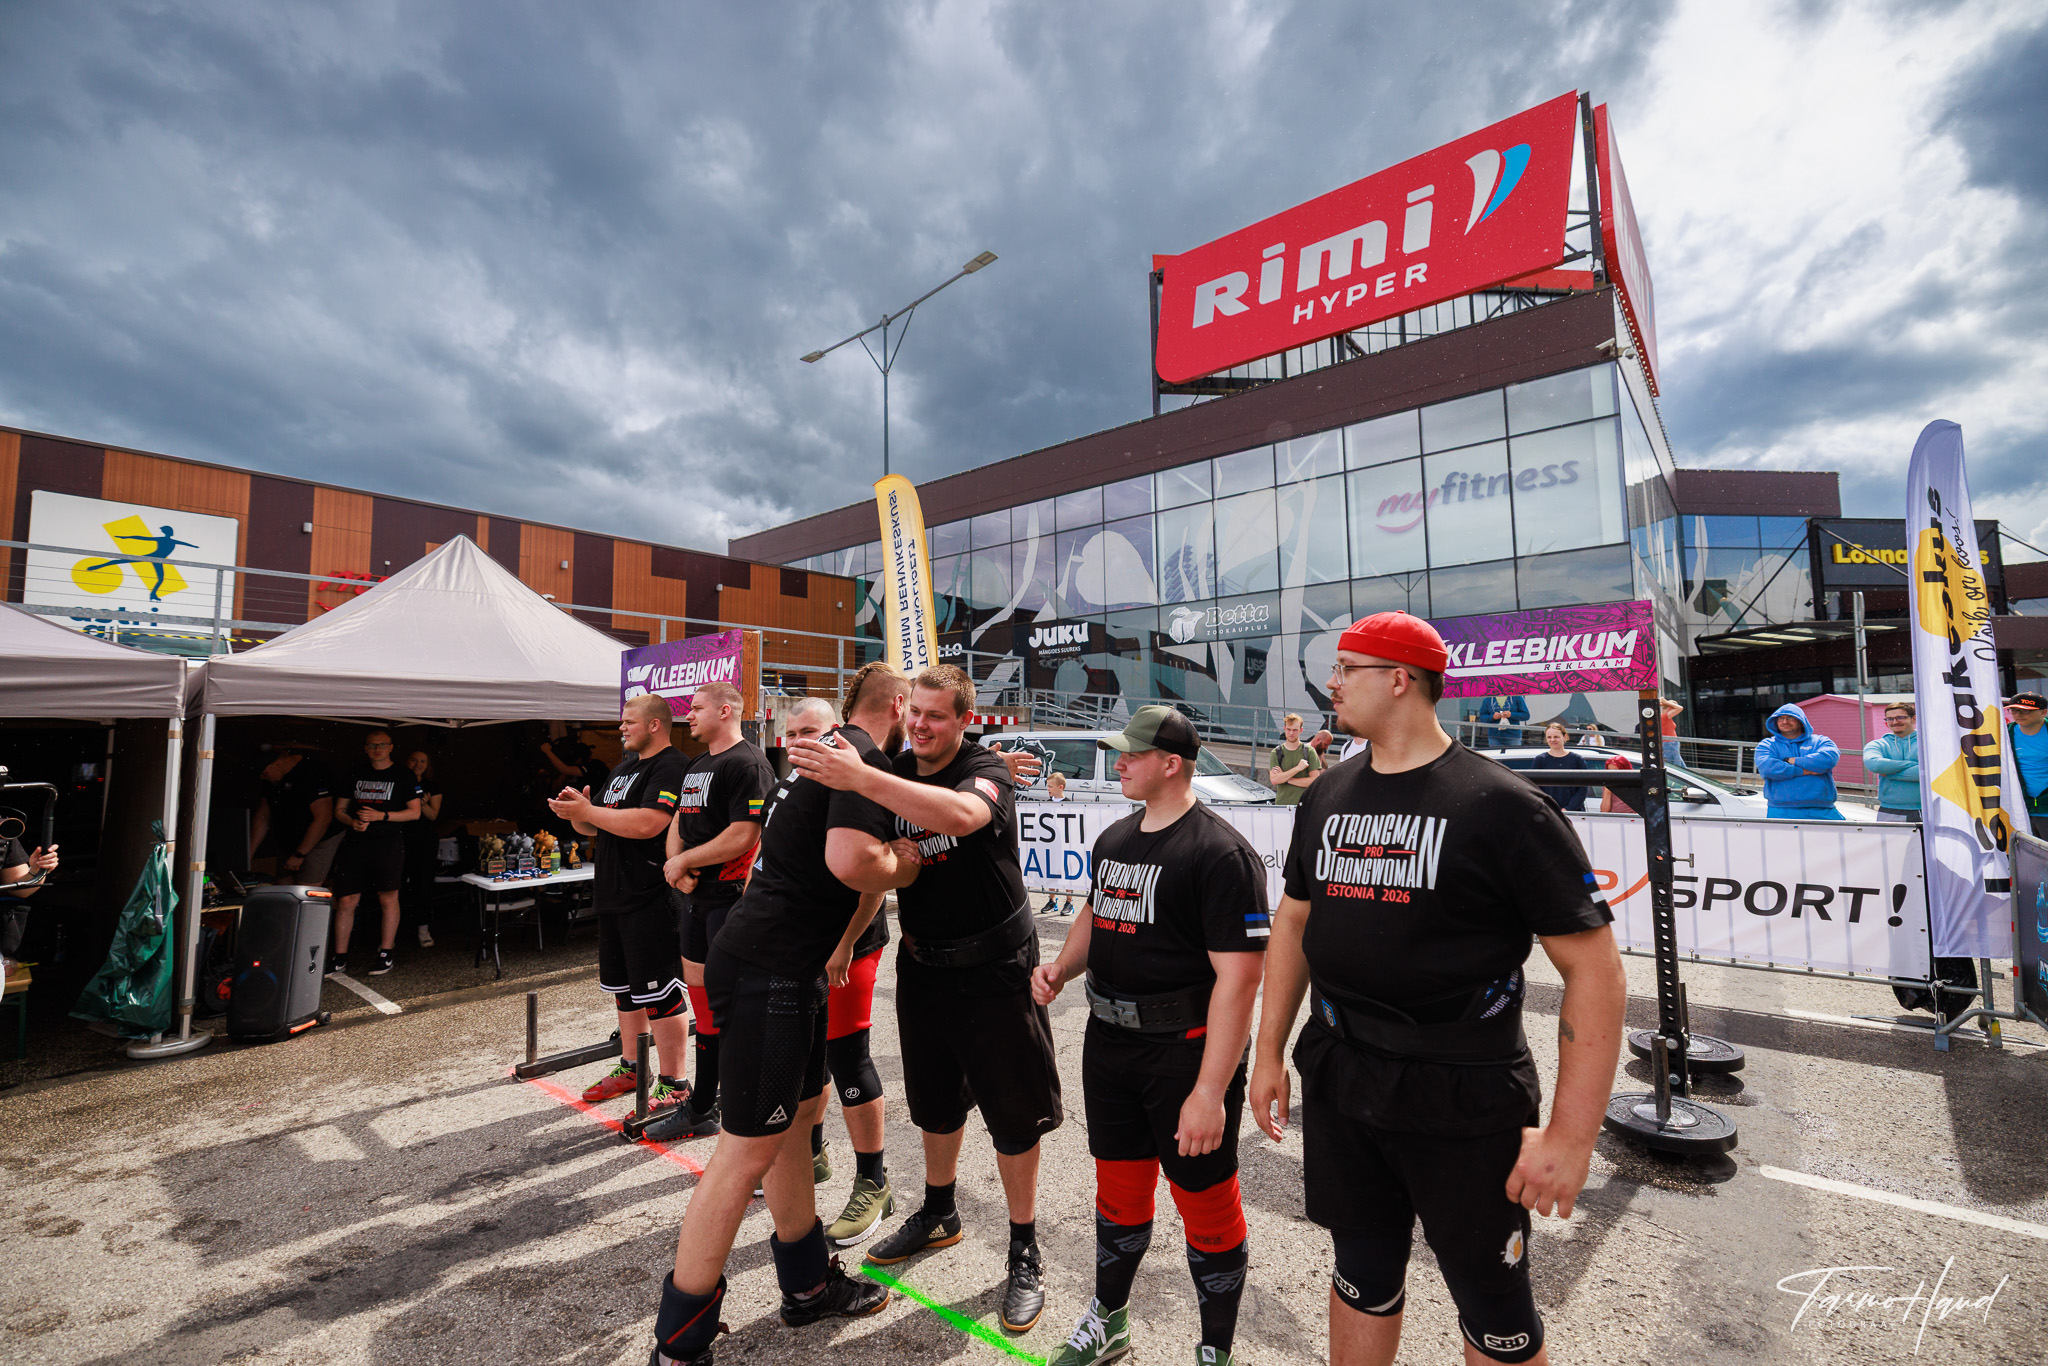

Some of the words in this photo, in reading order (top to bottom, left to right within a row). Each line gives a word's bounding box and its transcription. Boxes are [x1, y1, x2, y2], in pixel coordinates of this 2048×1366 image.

[1292, 262, 1428, 325] HYPER
[1961, 576, 1986, 600] on
[1205, 603, 1269, 627] Betta
[1028, 621, 1089, 648] JUKU
[1206, 624, 1268, 636] ZOOKAUPLUS
[1447, 630, 1638, 667] KLEEBIKUM
[650, 656, 736, 690] KLEEBIKUM
[1544, 659, 1624, 671] REKLAAM
[1020, 812, 1085, 844] ESTI
[1318, 814, 1448, 852] STRONGMAN
[1363, 845, 1384, 858] PRO
[1315, 849, 1440, 890] STRONGWOMAN
[1326, 883, 1375, 900] ESTONIA
[1381, 888, 1411, 904] 2026
[1117, 922, 1137, 934] 2026
